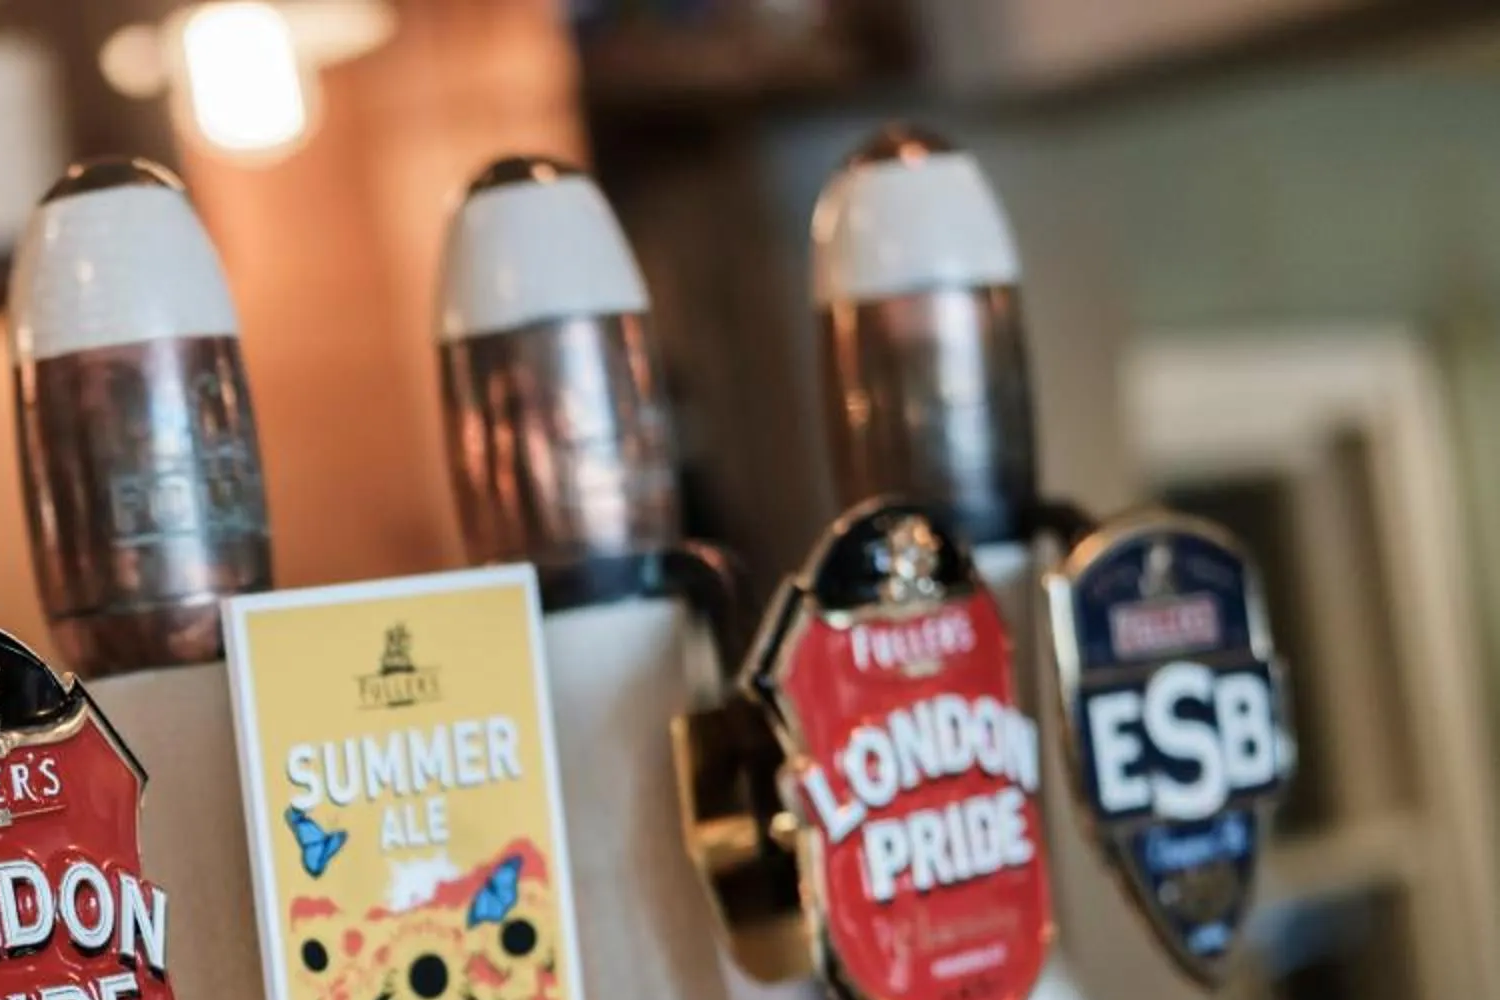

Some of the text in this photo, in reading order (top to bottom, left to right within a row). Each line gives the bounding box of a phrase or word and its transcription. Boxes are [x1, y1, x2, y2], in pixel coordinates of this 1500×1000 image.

[286, 715, 524, 810] SUMMER
[804, 694, 1040, 845] LONDON
[1087, 661, 1276, 821] ESB
[380, 797, 449, 850] ALE
[862, 788, 1036, 903] PRIDE
